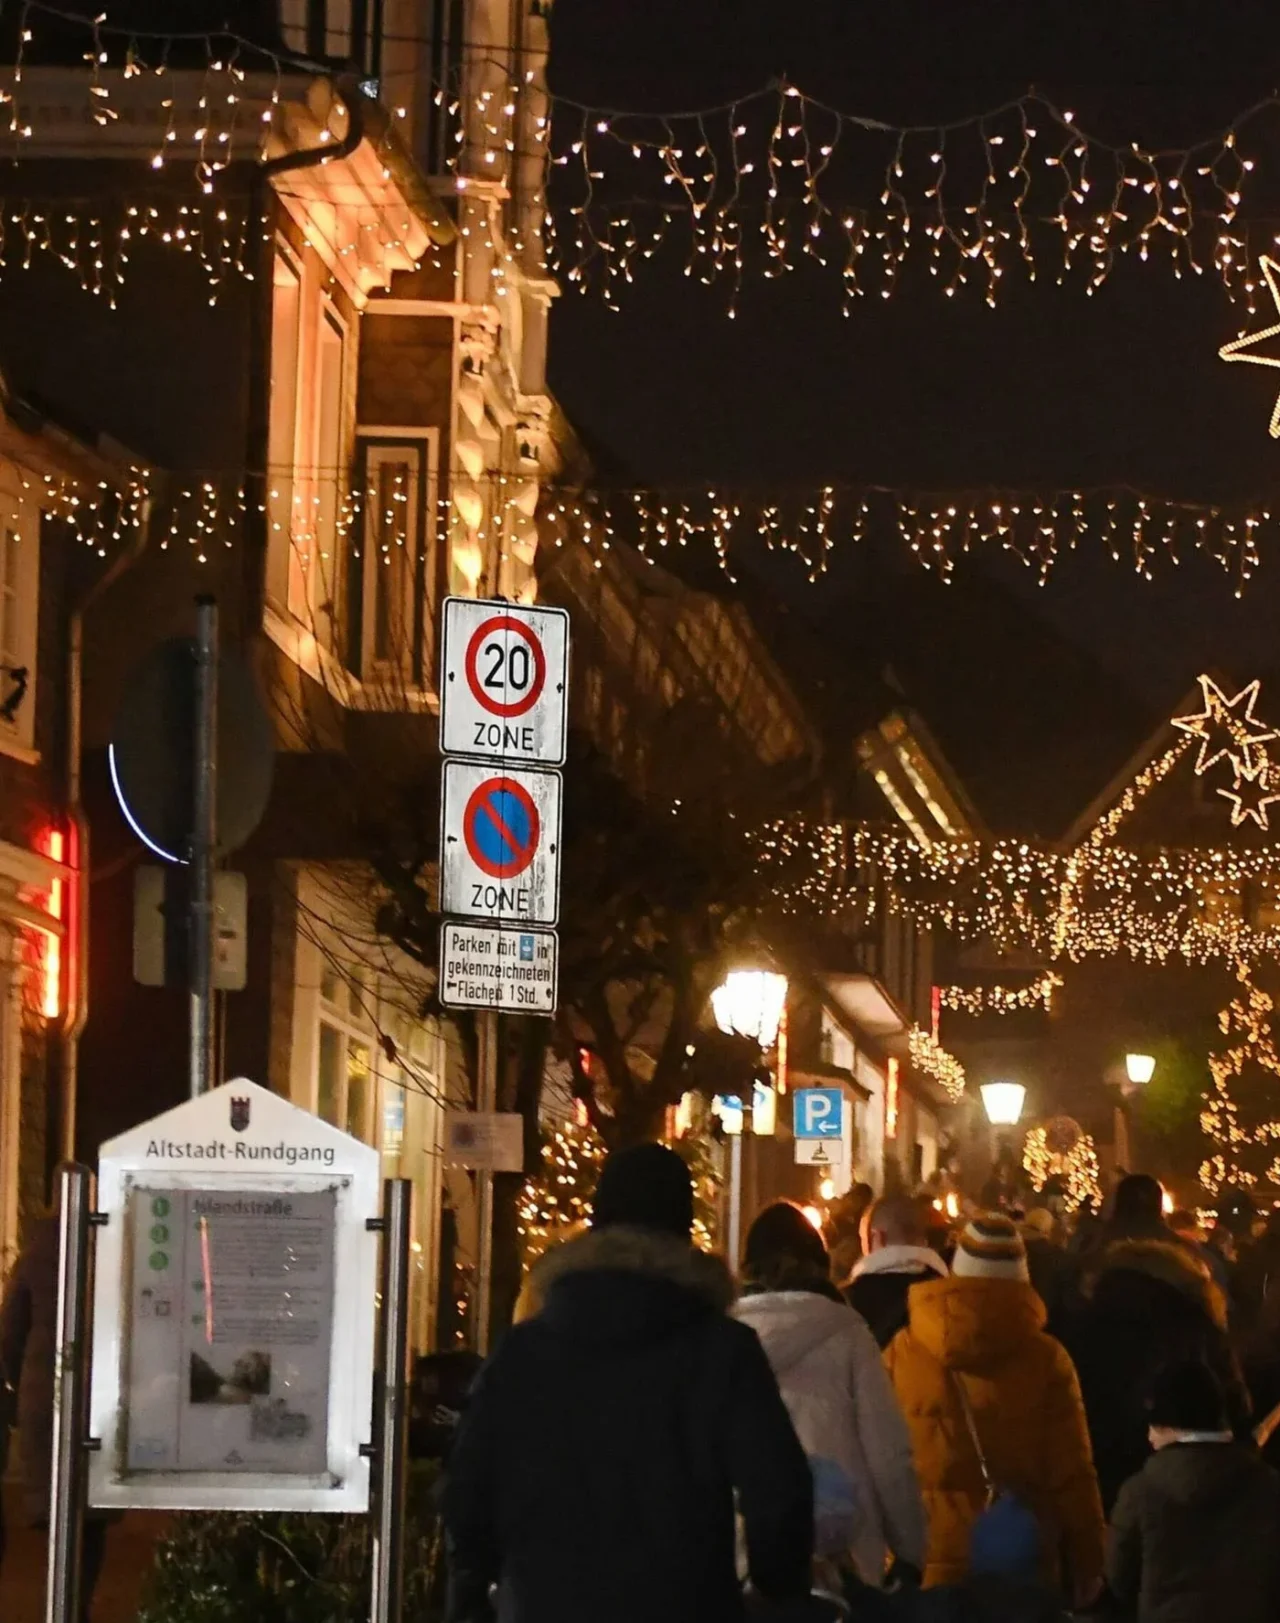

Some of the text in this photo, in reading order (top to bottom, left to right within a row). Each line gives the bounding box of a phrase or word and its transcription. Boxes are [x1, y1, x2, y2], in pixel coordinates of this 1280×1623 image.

[484, 643, 529, 690] 20
[473, 722, 534, 751] ZONE
[471, 884, 529, 912] ZONE
[452, 933, 548, 959] Parken mit in
[448, 958, 550, 982] gekennzeichneten
[458, 980, 539, 1004] Flächen 1 Std.
[805, 1094, 831, 1131] P
[146, 1140, 335, 1166] Altstadt-Rundgang
